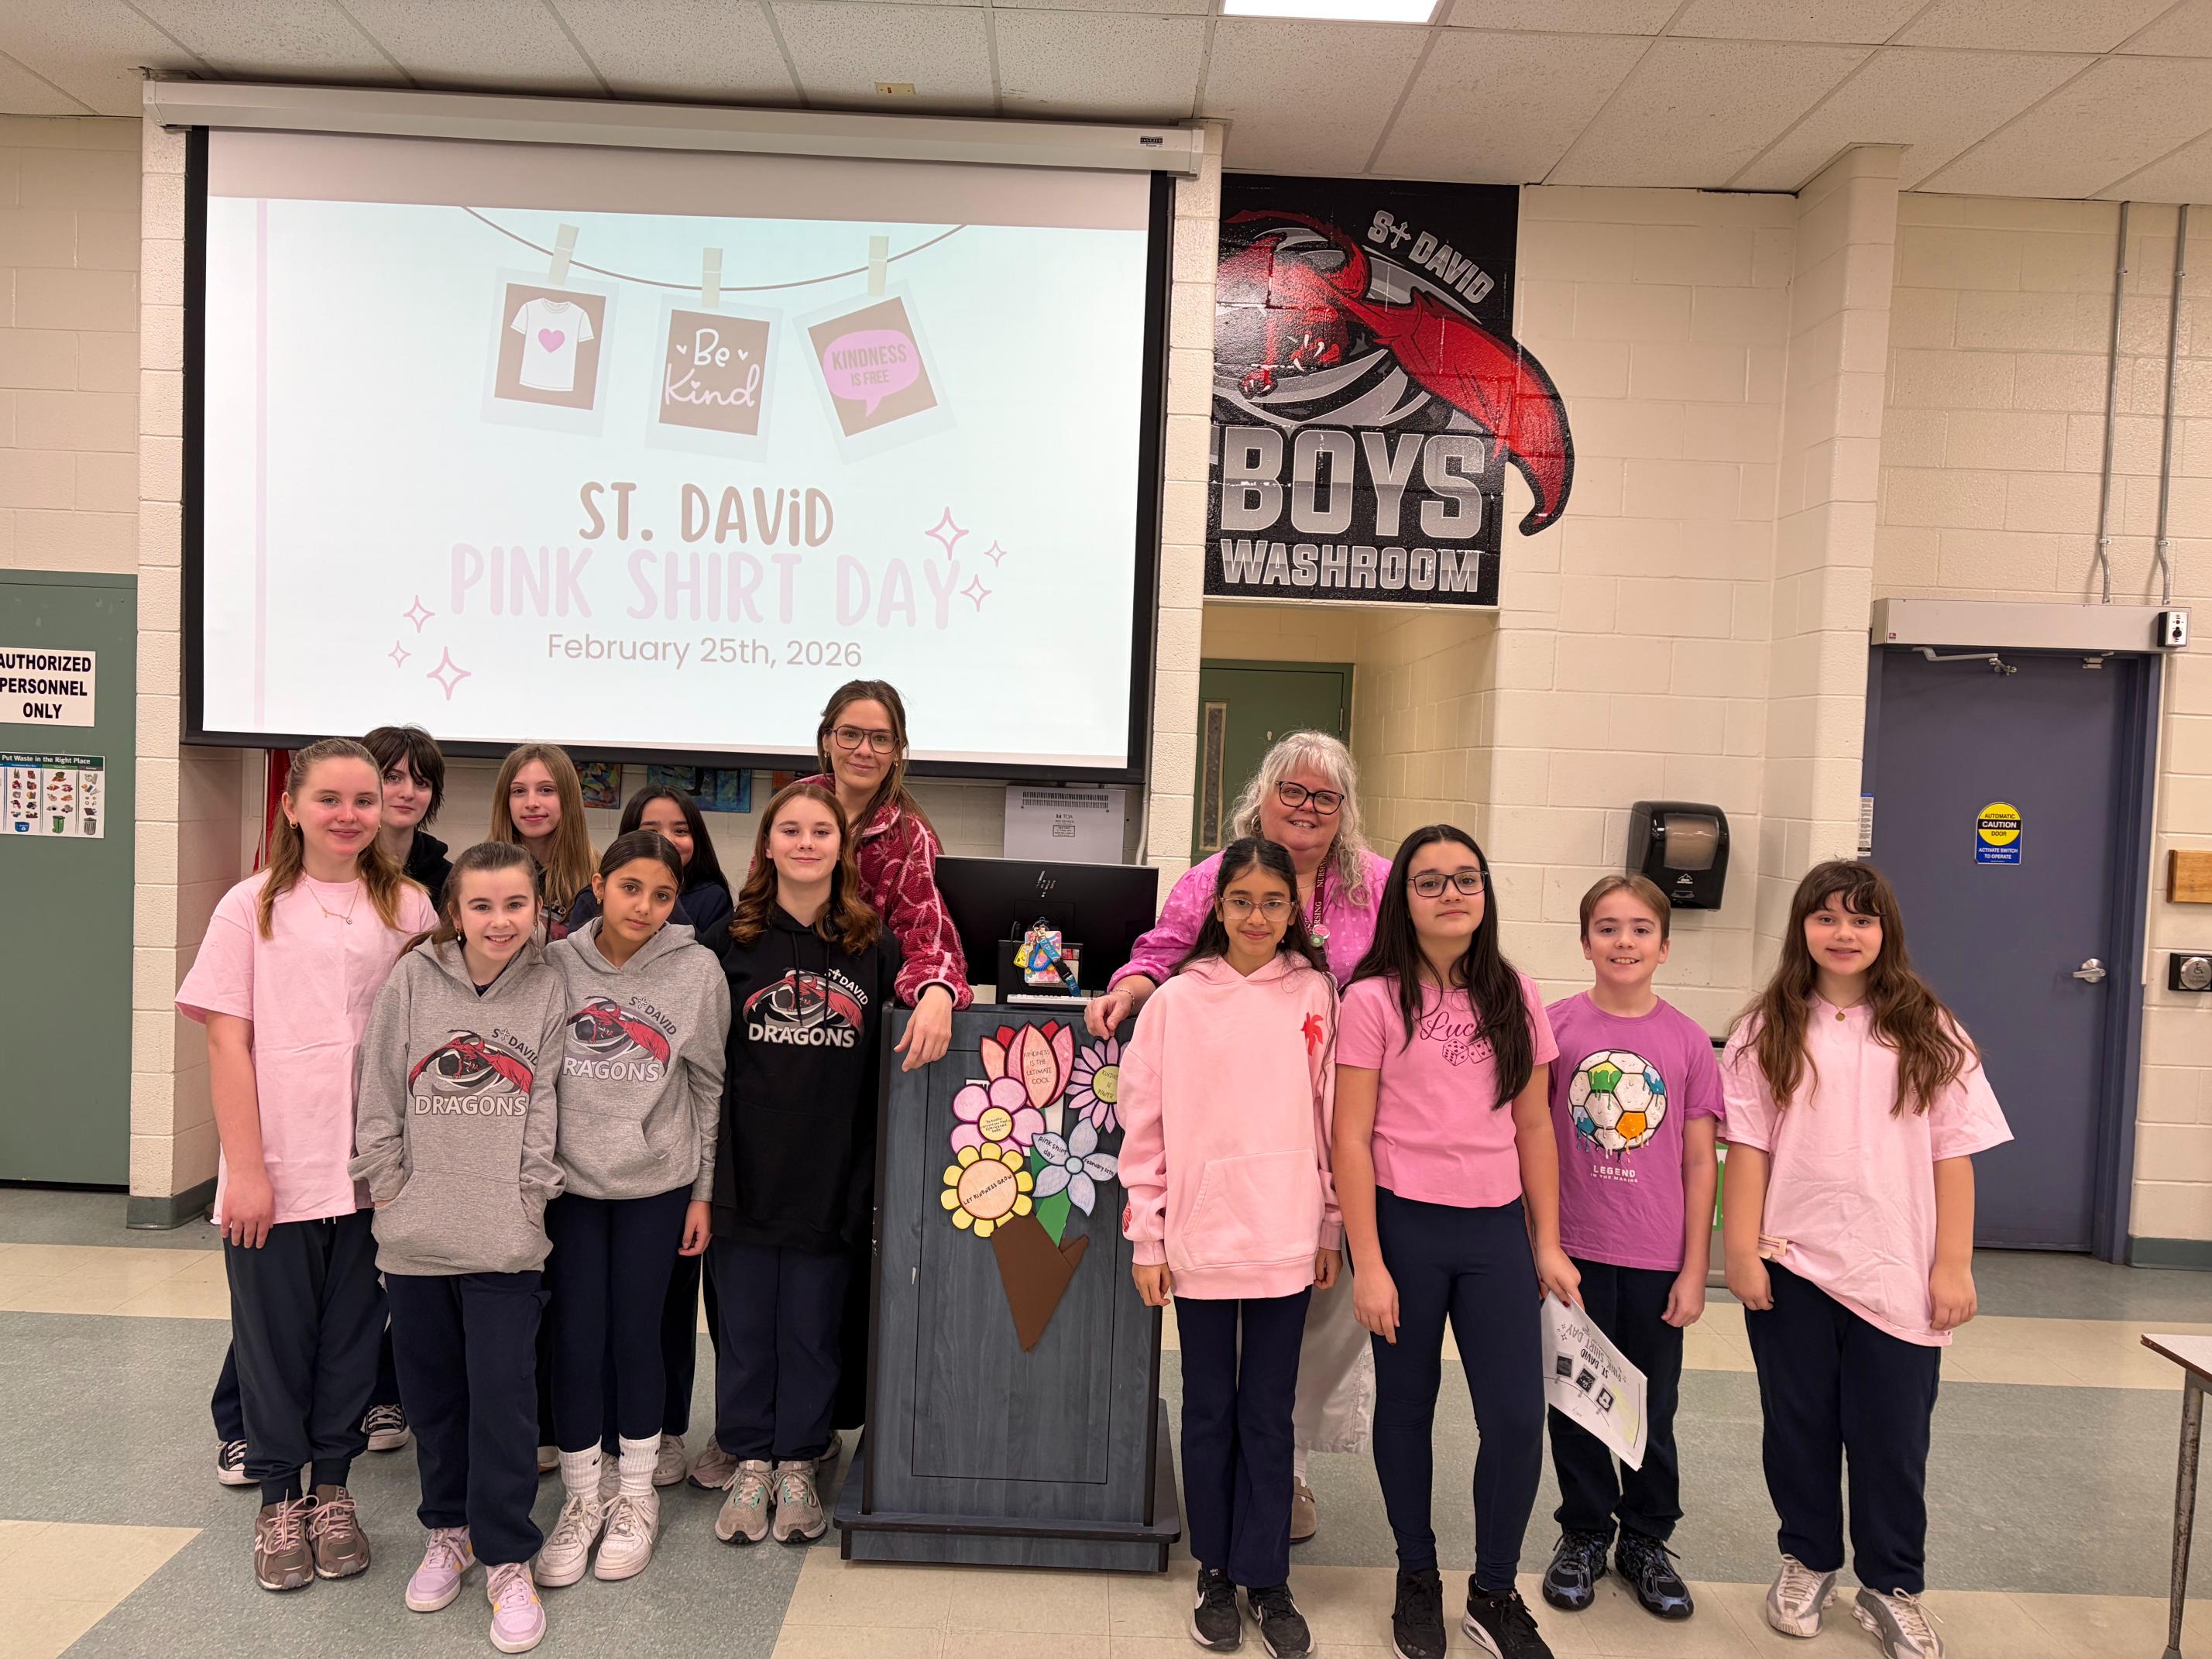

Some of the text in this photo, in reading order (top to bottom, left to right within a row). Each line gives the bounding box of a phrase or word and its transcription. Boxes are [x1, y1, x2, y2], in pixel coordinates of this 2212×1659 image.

[1408, 231, 1495, 304] DAVID
[694, 328, 730, 367] Be
[832, 344, 907, 371] KINDNESS
[665, 363, 760, 407] Kind
[850, 369, 890, 386] IS FREE
[1221, 427, 1486, 538] BOYS
[579, 481, 654, 541] ST.
[1220, 539, 1482, 592] WASHROOM
[451, 543, 960, 630] PINK SHIRT DAY
[548, 634, 862, 670] February 25th, 2026
[0, 677, 88, 696] PERSONNEL
[22, 702, 63, 719] ONLY
[1317, 858, 1327, 888] NURSIN
[1314, 901, 1322, 926] RSING
[839, 975, 869, 1006] DAVID
[644, 1004, 678, 1036] DAVID
[1420, 1011, 1476, 1042] Luc
[748, 1022, 855, 1048] DRAGONS
[1023, 1049, 1051, 1057] KINDNESS
[562, 1056, 659, 1083] RAGONS
[1026, 1066, 1053, 1077] ULTIMATE
[1032, 1077, 1051, 1085] COOL
[414, 1094, 527, 1117] DRAGONS
[1097, 1088, 1115, 1101] POWER
[1038, 1136, 1067, 1156] pink shirt
[1043, 1149, 1055, 1159] day
[1593, 1165, 1636, 1178] LEGEND
[963, 1174, 1012, 1205] LET KINDNESS GROW
[1566, 1324, 1584, 1343] DAY
[1585, 1338, 1605, 1363] SHIRT
